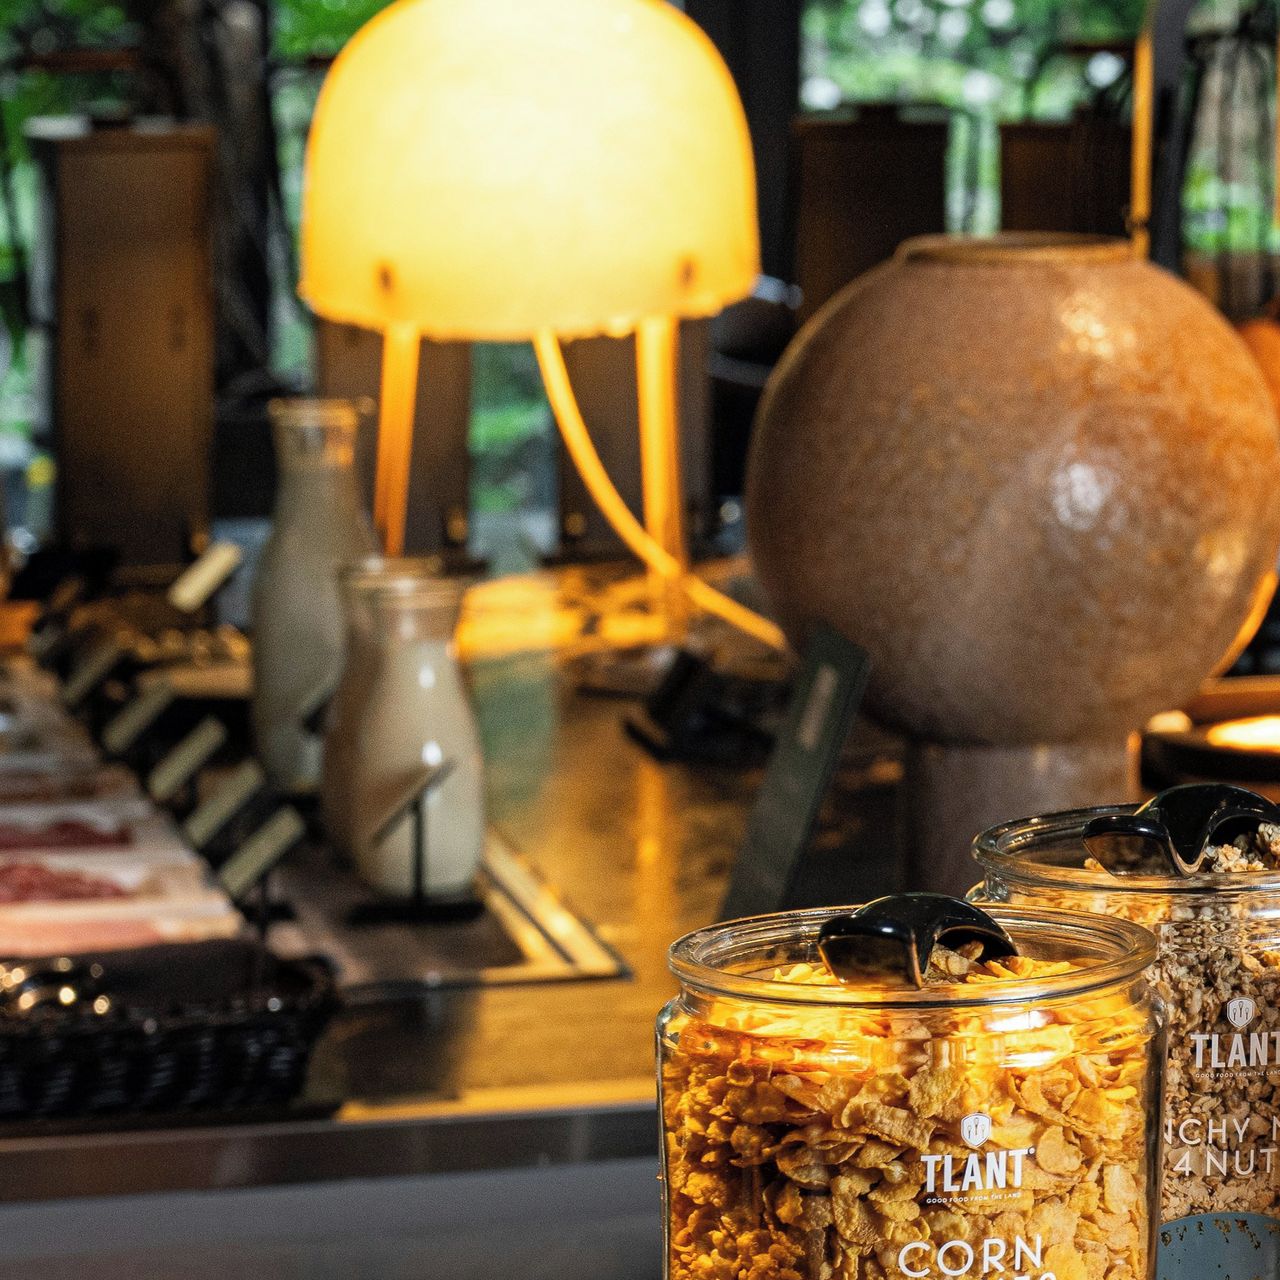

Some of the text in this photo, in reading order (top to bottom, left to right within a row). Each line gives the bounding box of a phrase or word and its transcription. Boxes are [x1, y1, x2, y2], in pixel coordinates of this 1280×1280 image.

[921, 1148, 1029, 1192] TLANT
[1173, 1151, 1192, 1177] 4
[898, 1234, 1042, 1278] CORN
